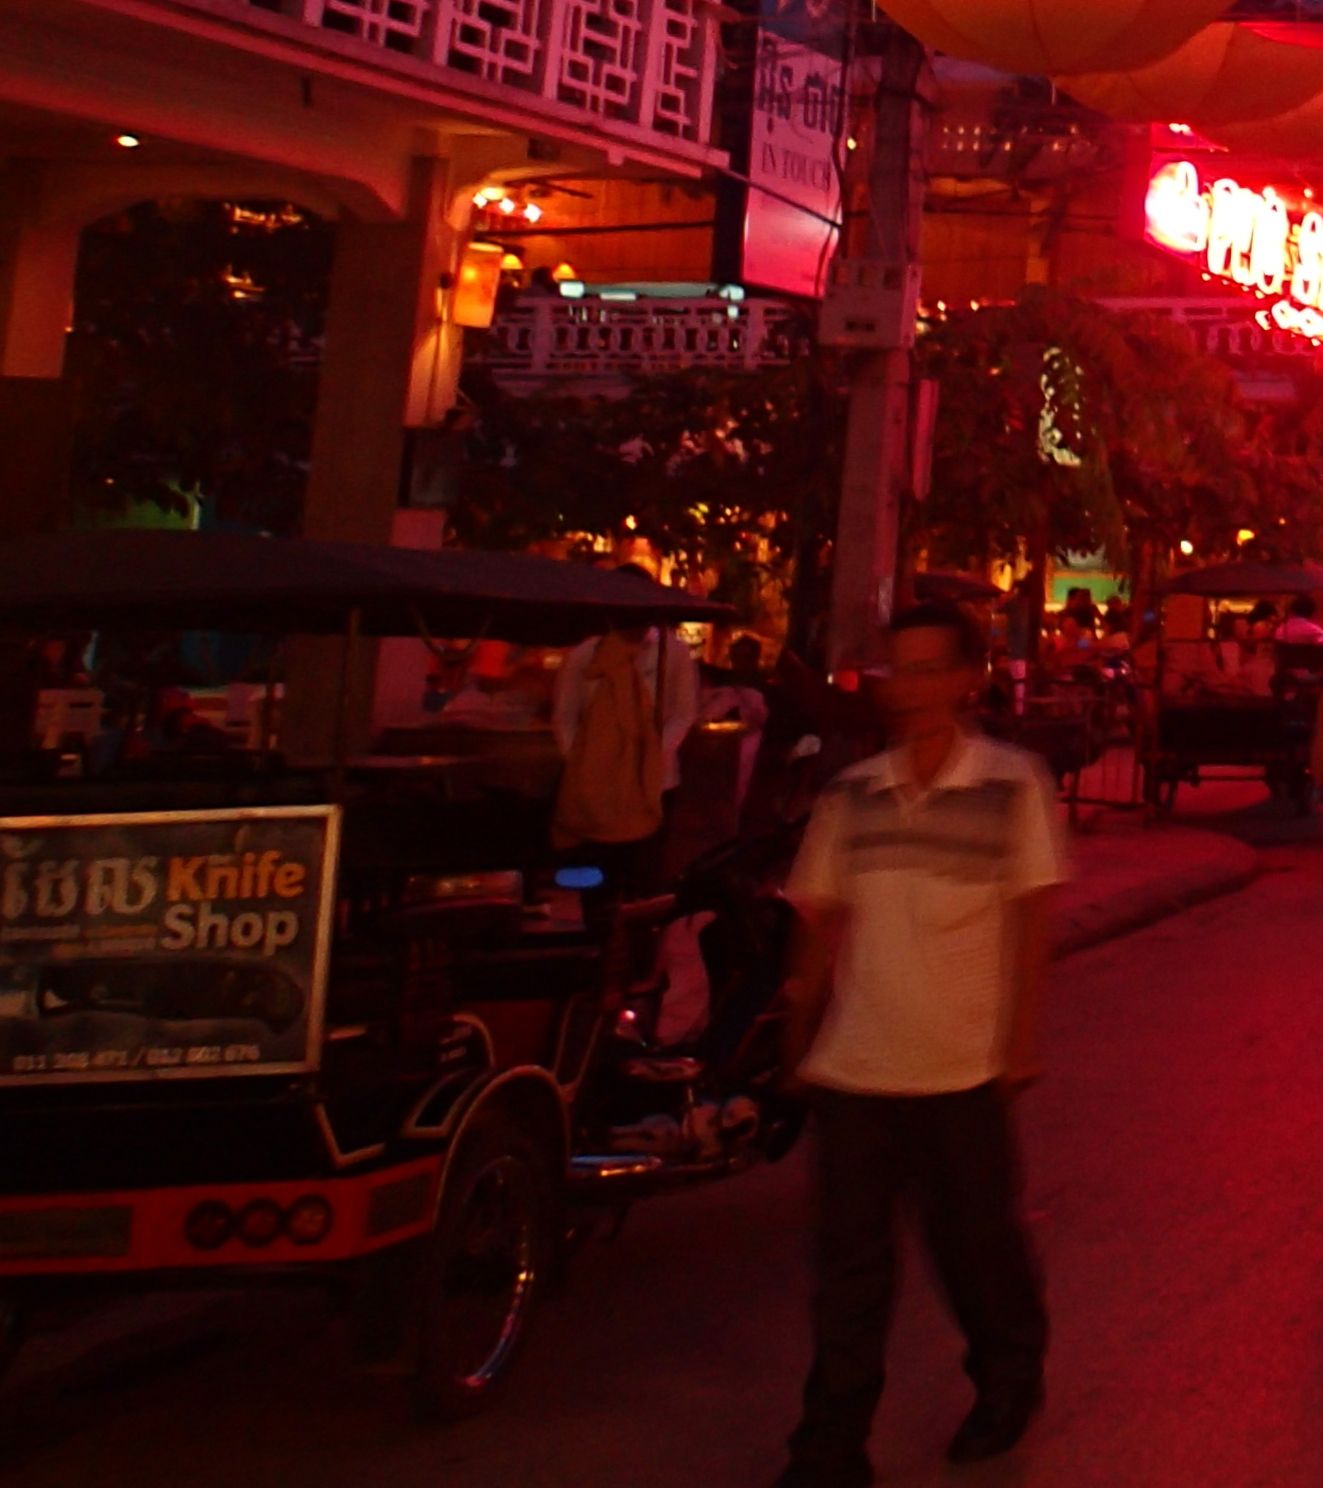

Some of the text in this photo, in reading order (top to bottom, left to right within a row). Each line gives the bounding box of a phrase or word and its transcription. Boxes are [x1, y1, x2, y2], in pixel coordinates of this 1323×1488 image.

[782, 147, 832, 193] TOUCH
[168, 851, 305, 901] Knife
[161, 903, 299, 956] Shop
